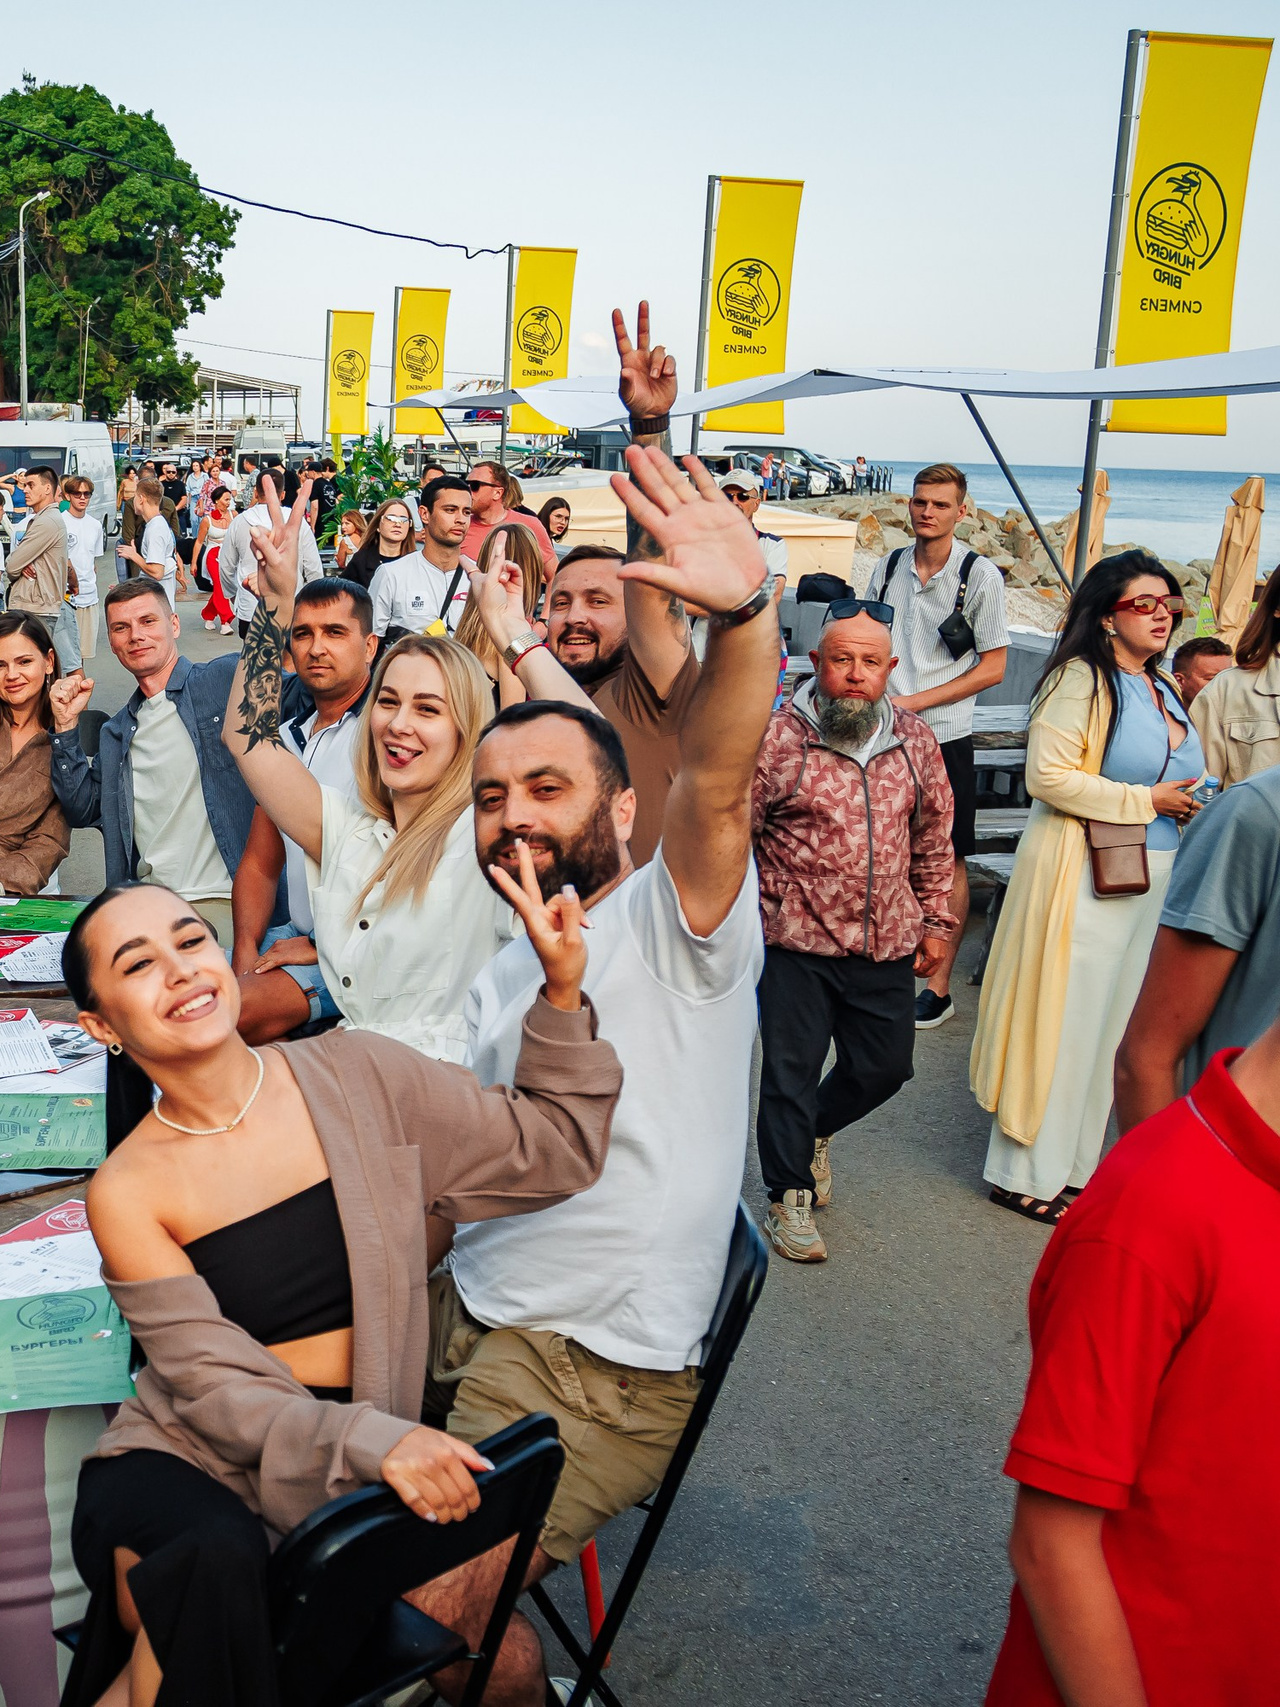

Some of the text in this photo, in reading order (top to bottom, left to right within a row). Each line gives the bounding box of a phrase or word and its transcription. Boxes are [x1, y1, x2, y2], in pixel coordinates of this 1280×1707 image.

[38, 1316, 86, 1331] HUNGRY
[48, 1326, 76, 1336] BIRD
[10, 1337, 84, 1353] БУРГЕРЫ
